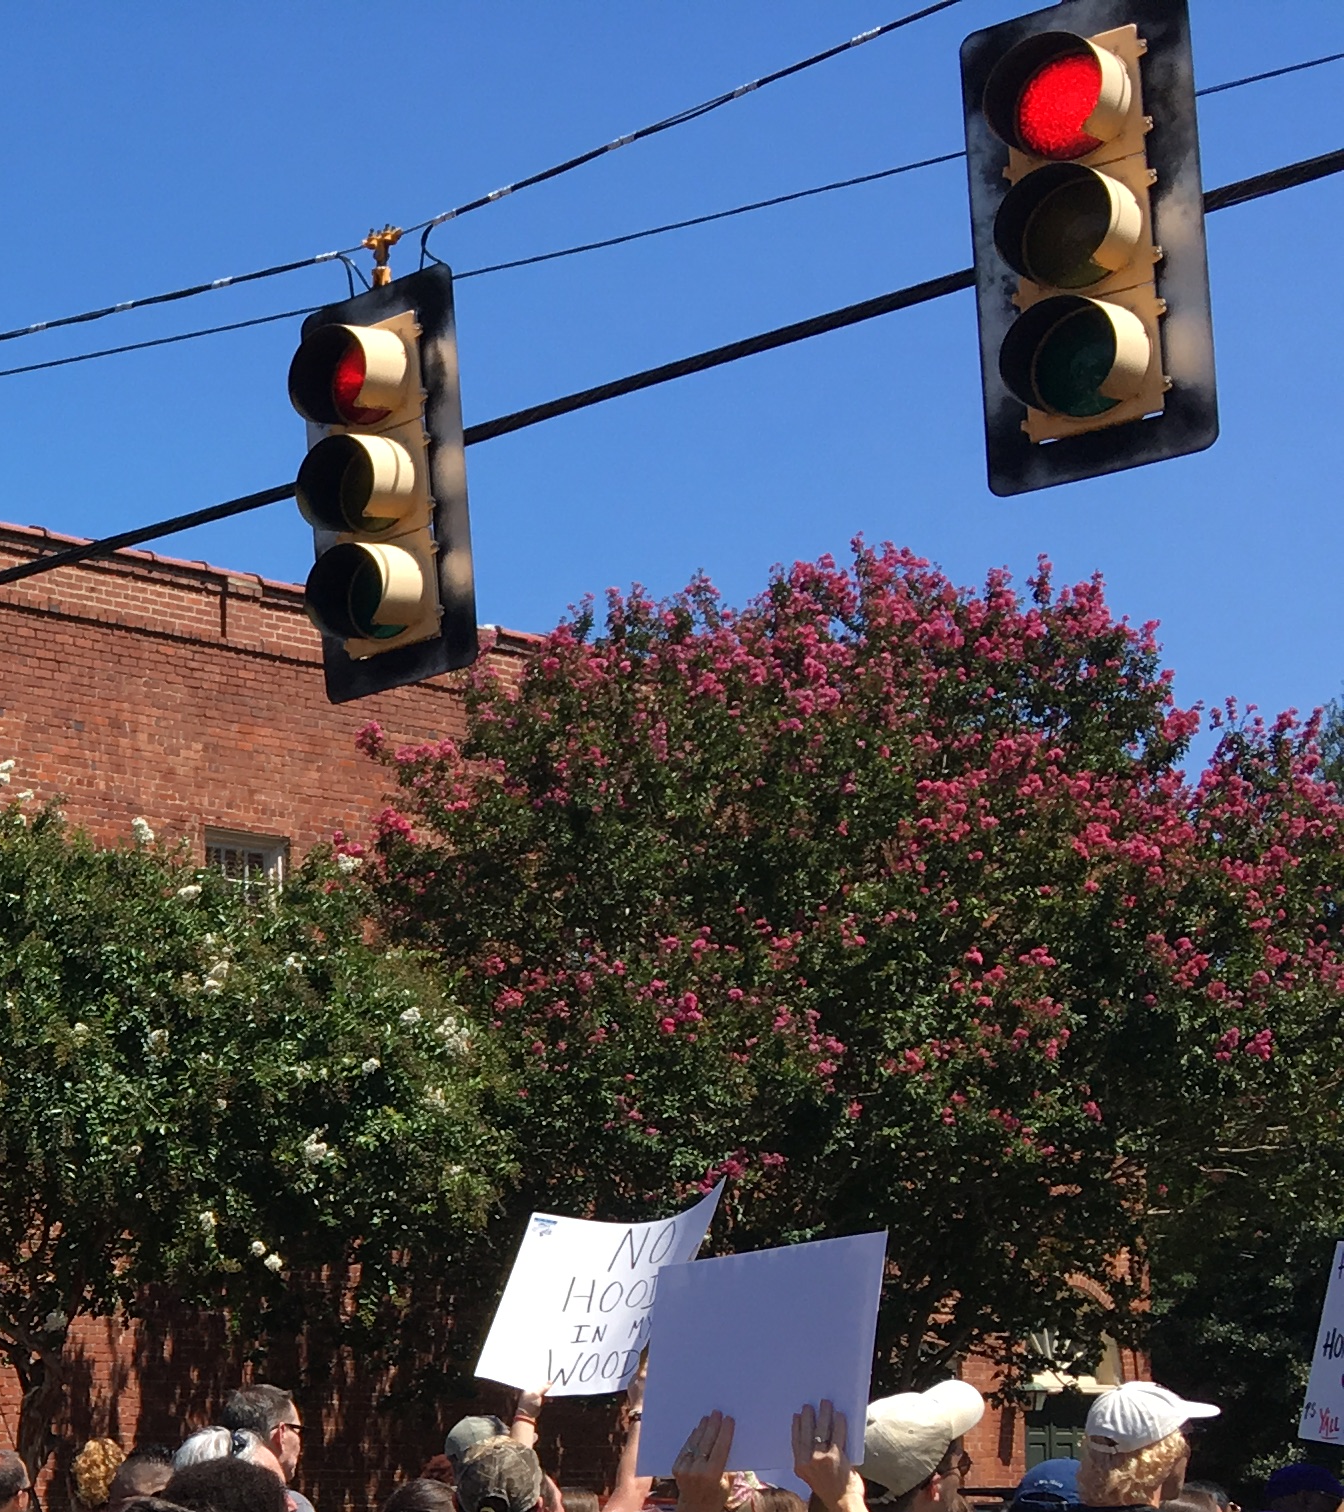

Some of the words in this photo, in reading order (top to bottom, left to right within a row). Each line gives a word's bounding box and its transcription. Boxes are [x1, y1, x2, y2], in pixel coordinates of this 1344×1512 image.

[607, 1220, 677, 1273] NO
[570, 1324, 608, 1344] IN
[628, 1316, 652, 1341] MY
